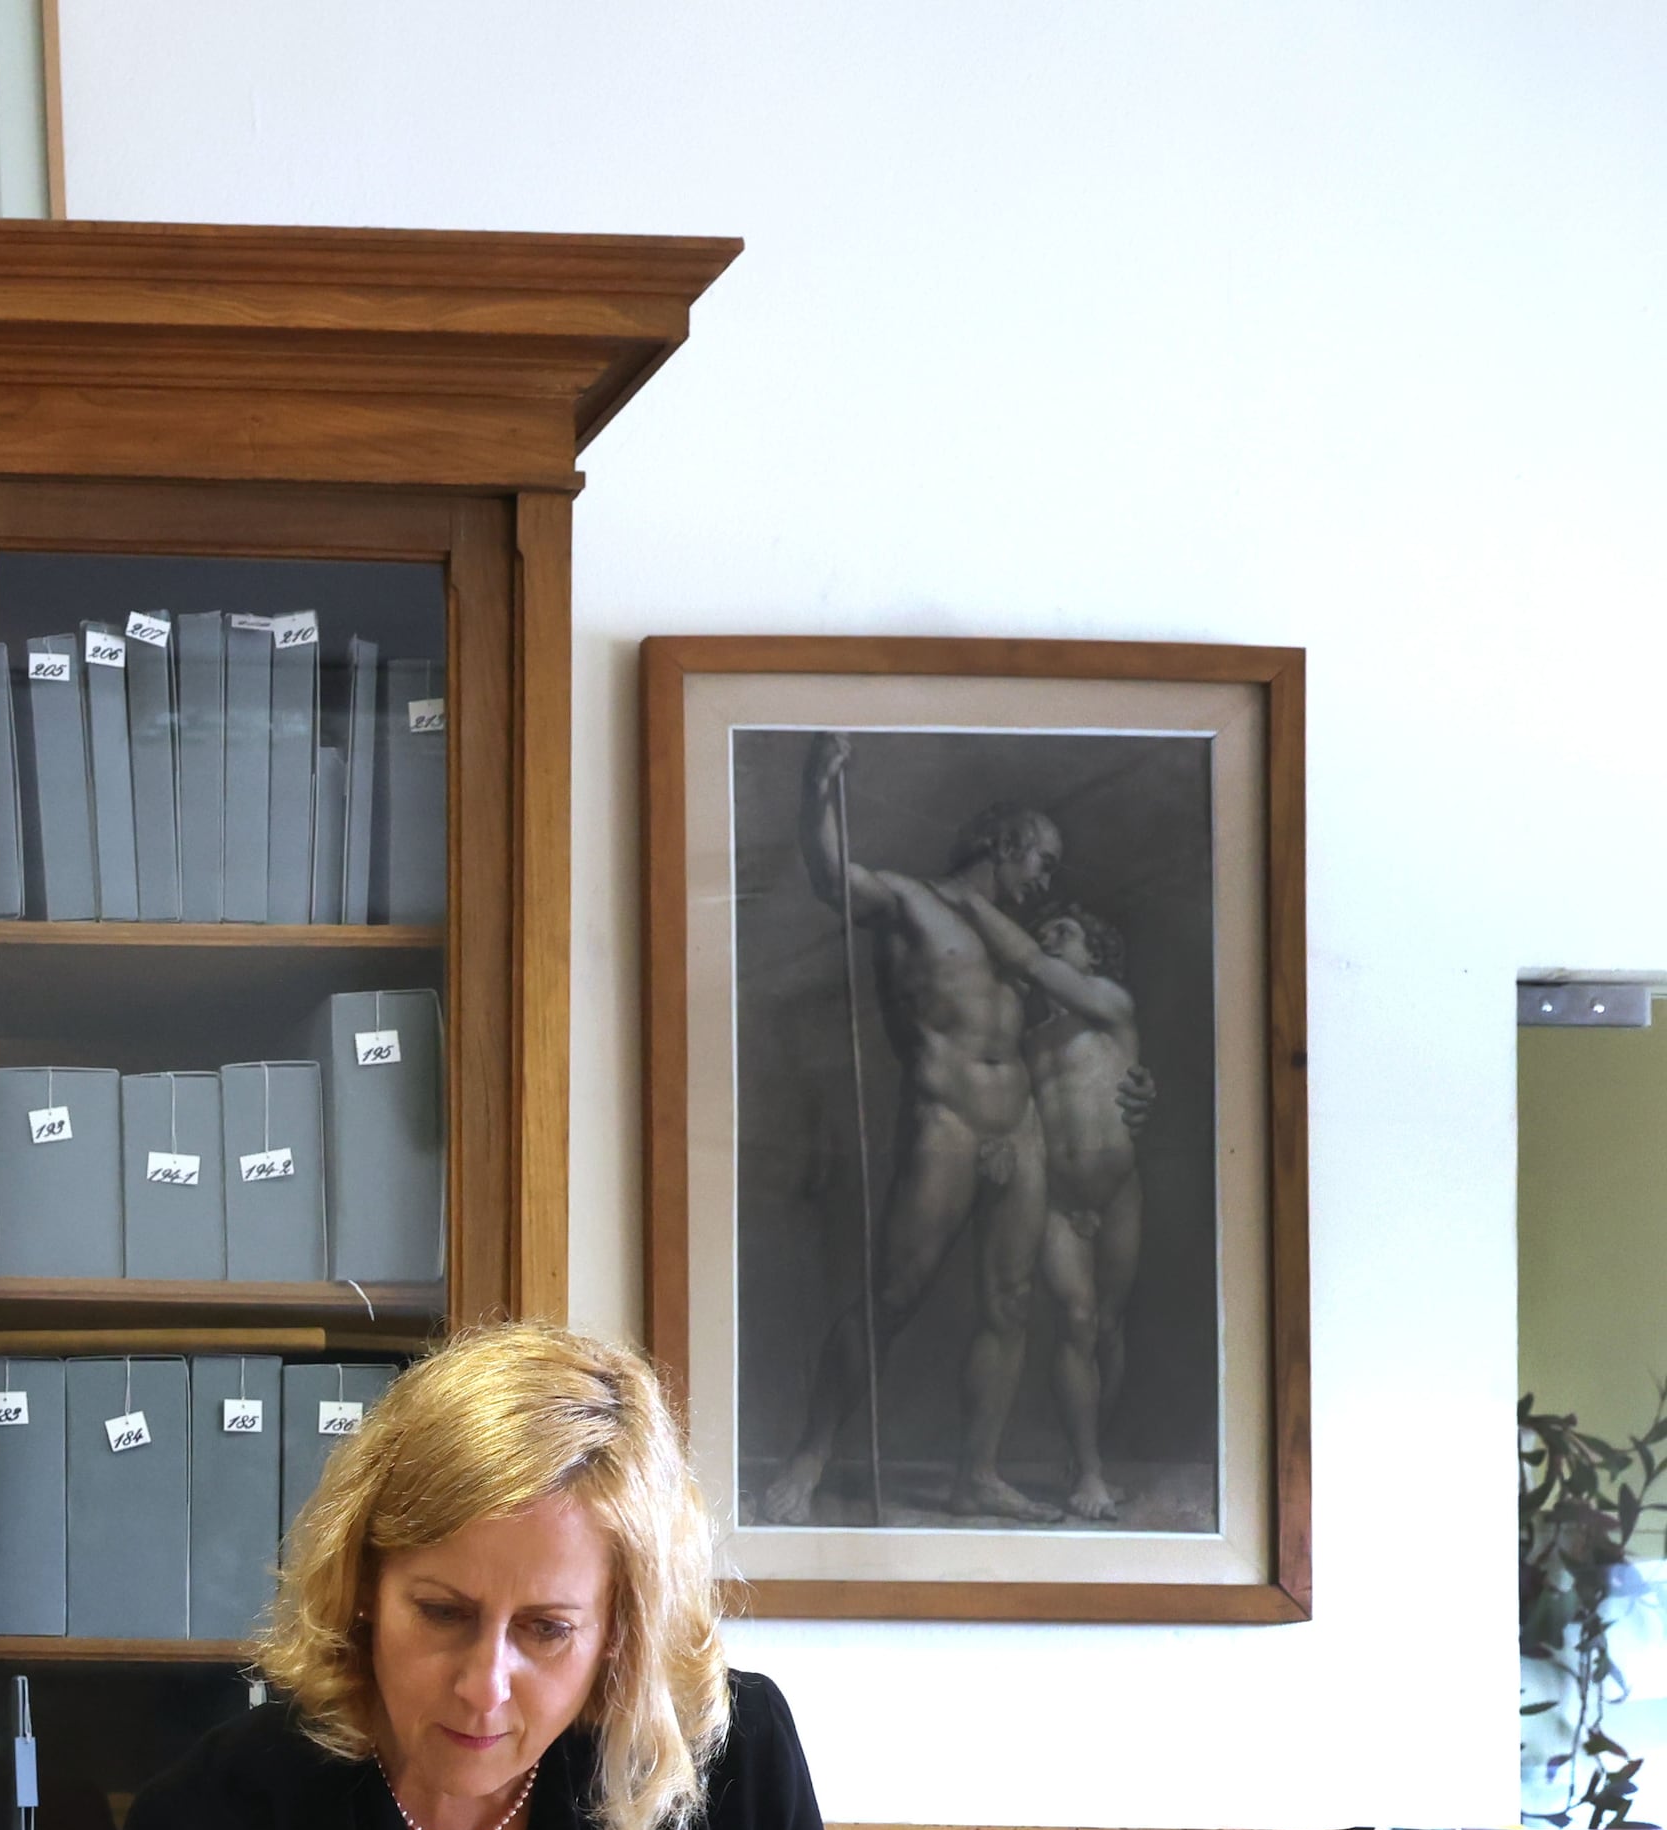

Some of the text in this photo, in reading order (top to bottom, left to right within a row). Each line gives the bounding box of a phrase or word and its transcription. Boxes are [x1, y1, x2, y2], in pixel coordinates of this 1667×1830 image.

[128, 625, 166, 640] 207
[279, 627, 315, 643] 210
[89, 646, 123, 660] 206
[33, 663, 66, 676] 205
[362, 1044, 395, 1063] 195
[35, 1120, 66, 1140] 193
[227, 1414, 260, 1430] 185
[323, 1417, 359, 1433] 186
[114, 1427, 144, 1447] 184
